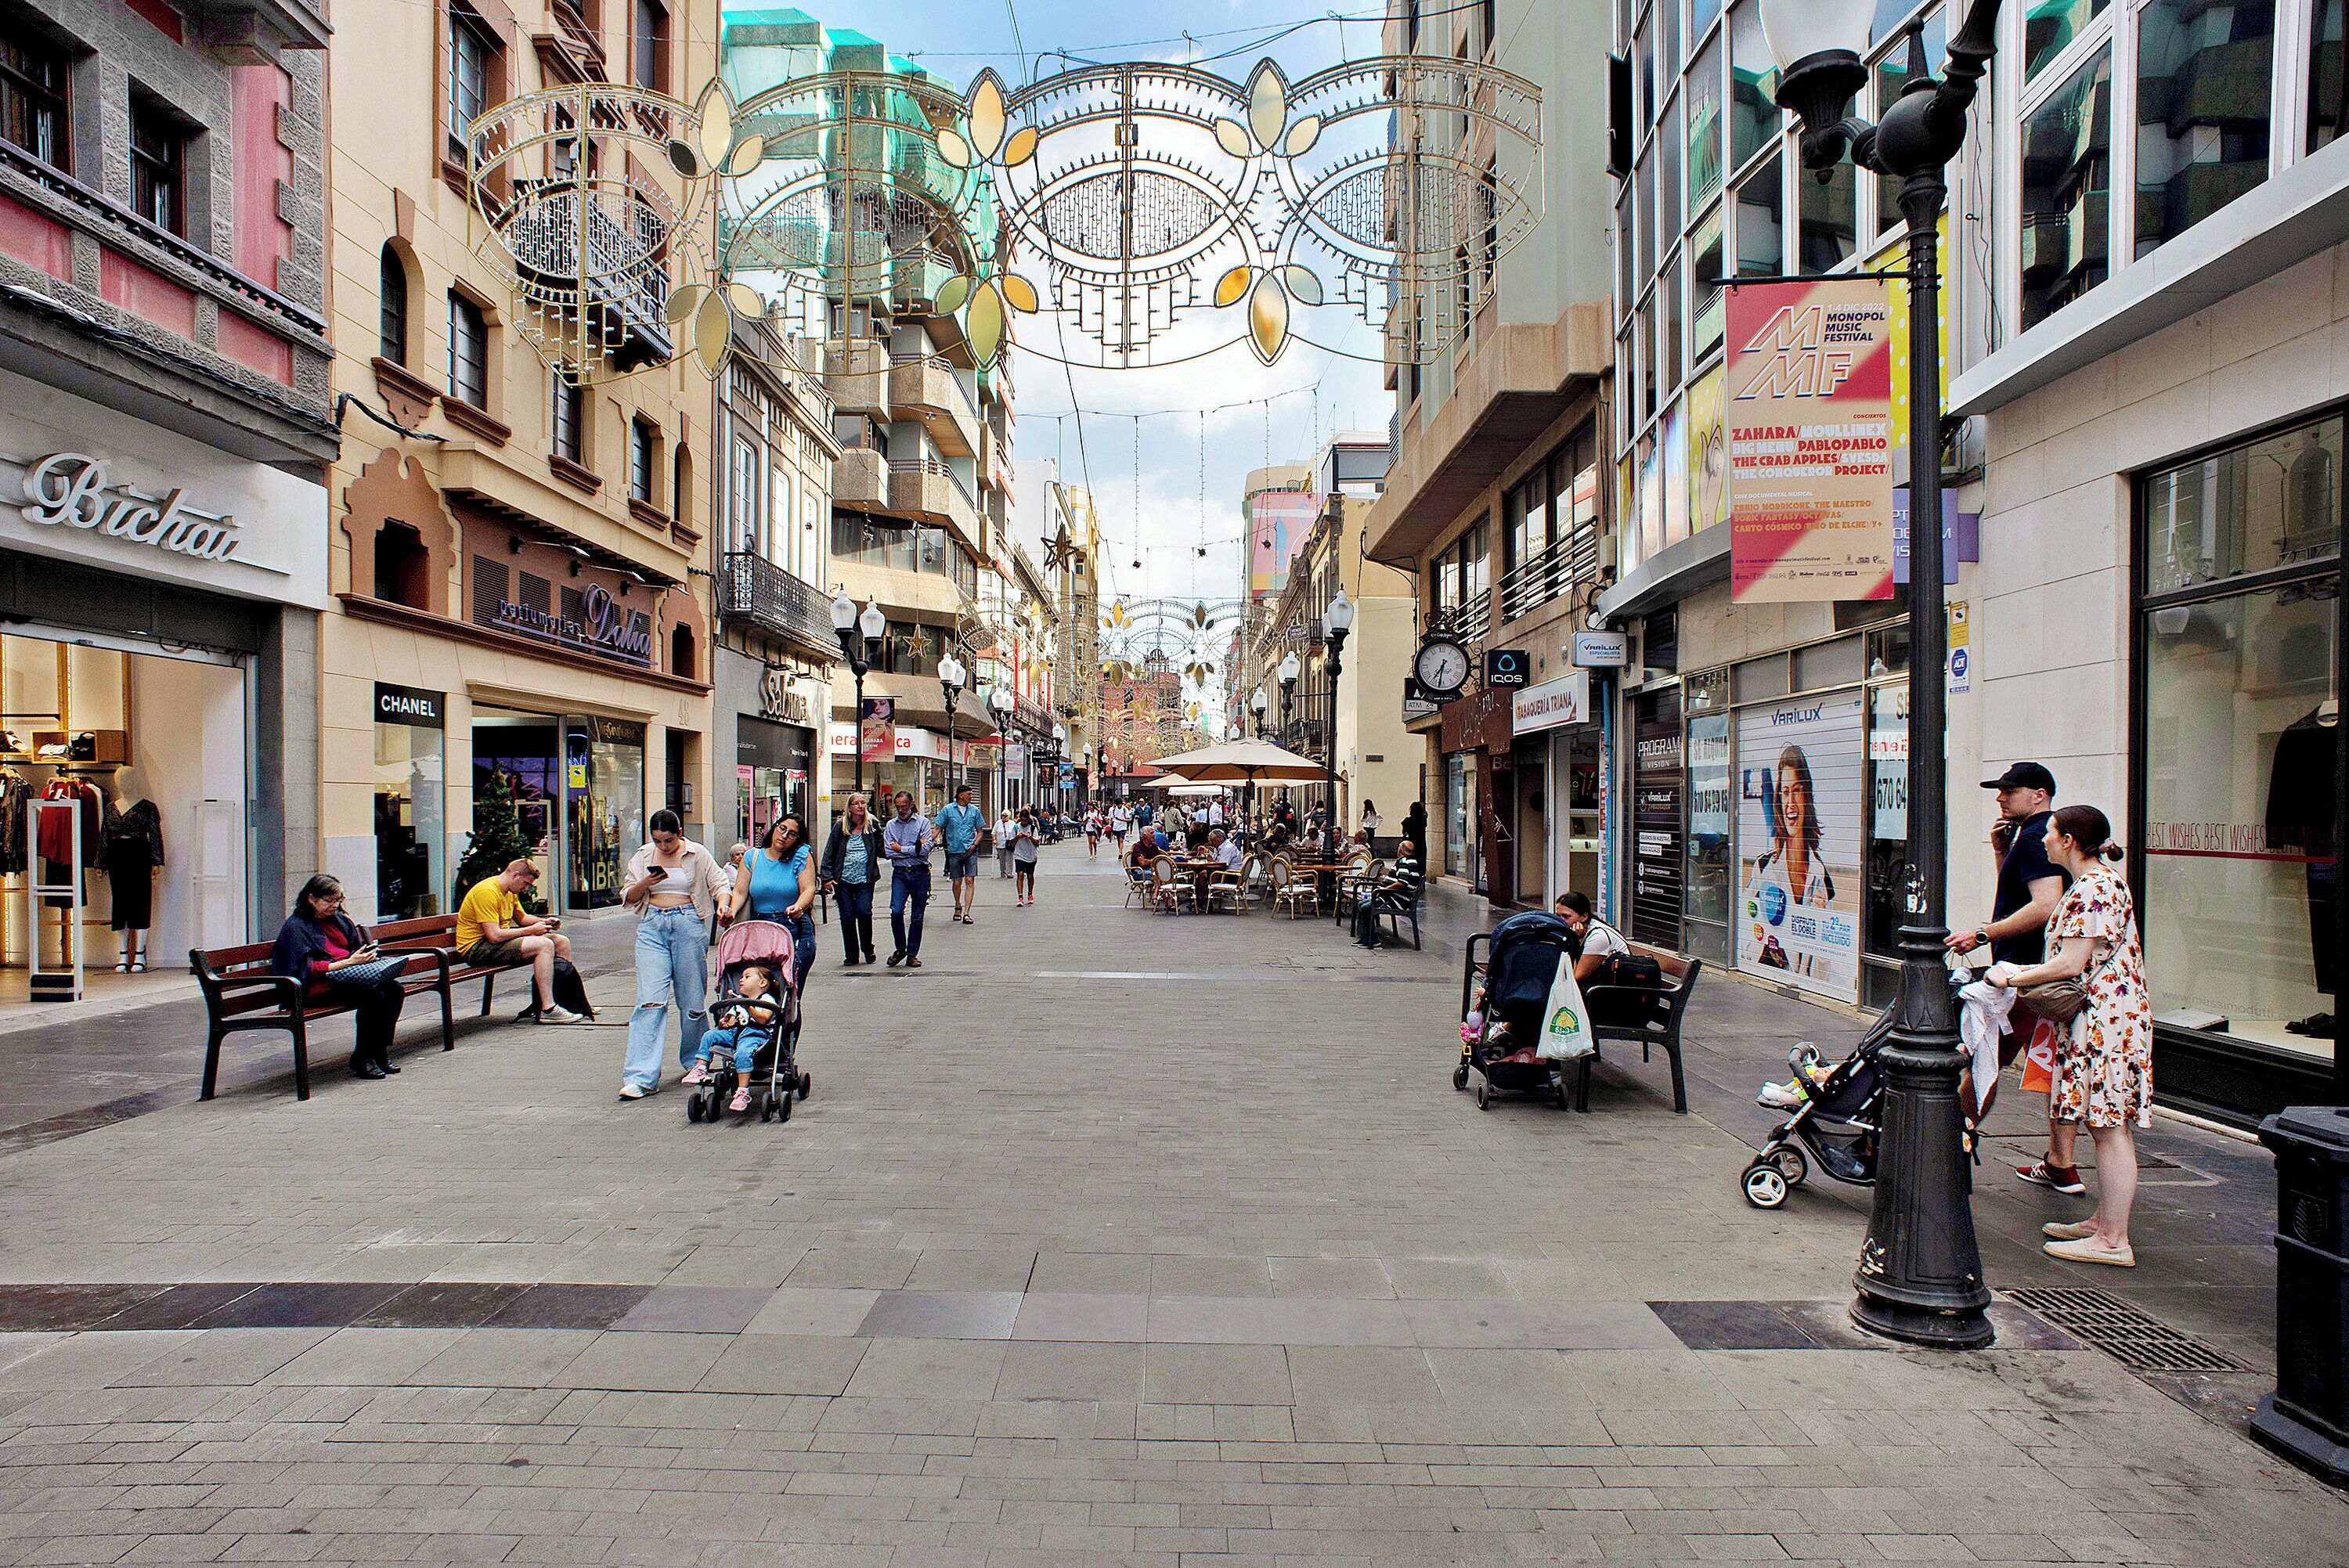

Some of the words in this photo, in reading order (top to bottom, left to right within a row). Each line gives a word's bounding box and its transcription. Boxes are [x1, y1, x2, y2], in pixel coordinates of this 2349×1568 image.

[1860, 302, 1885, 311] 2022
[1827, 312, 1885, 322] MONOPOL
[1825, 323, 1862, 332] MUSIC
[1824, 333, 1874, 342] FESTIVAL
[1732, 442, 1754, 454] BIG
[1733, 456, 1757, 467] THE
[1759, 456, 1791, 466] CRAB
[1733, 469, 1756, 479] THE
[1758, 466, 1833, 478] CONQUEROR
[1491, 674, 1523, 683] IQOS
[381, 694, 436, 717] CHANEL
[1517, 694, 1550, 719] TABAQUERÍA
[1551, 691, 1572, 712] TRIANA
[1771, 702, 1824, 726] VARILUX
[1638, 737, 1680, 757] PROGRAM
[1647, 760, 1669, 769] VISION
[1647, 791, 1672, 802] VARILUX
[1877, 777, 1893, 810] 670
[1896, 777, 1906, 810] 64
[2147, 822, 2166, 847] BEST
[2169, 823, 2200, 849] WISHES
[2204, 824, 2226, 850] BEST
[2229, 824, 2266, 852] WISHES
[1792, 914, 1816, 926] DISFRUTA
[1792, 923, 1798, 932] EL
[1798, 925, 1816, 935] DOBLE
[1821, 932, 1851, 946] INCLUIDO
